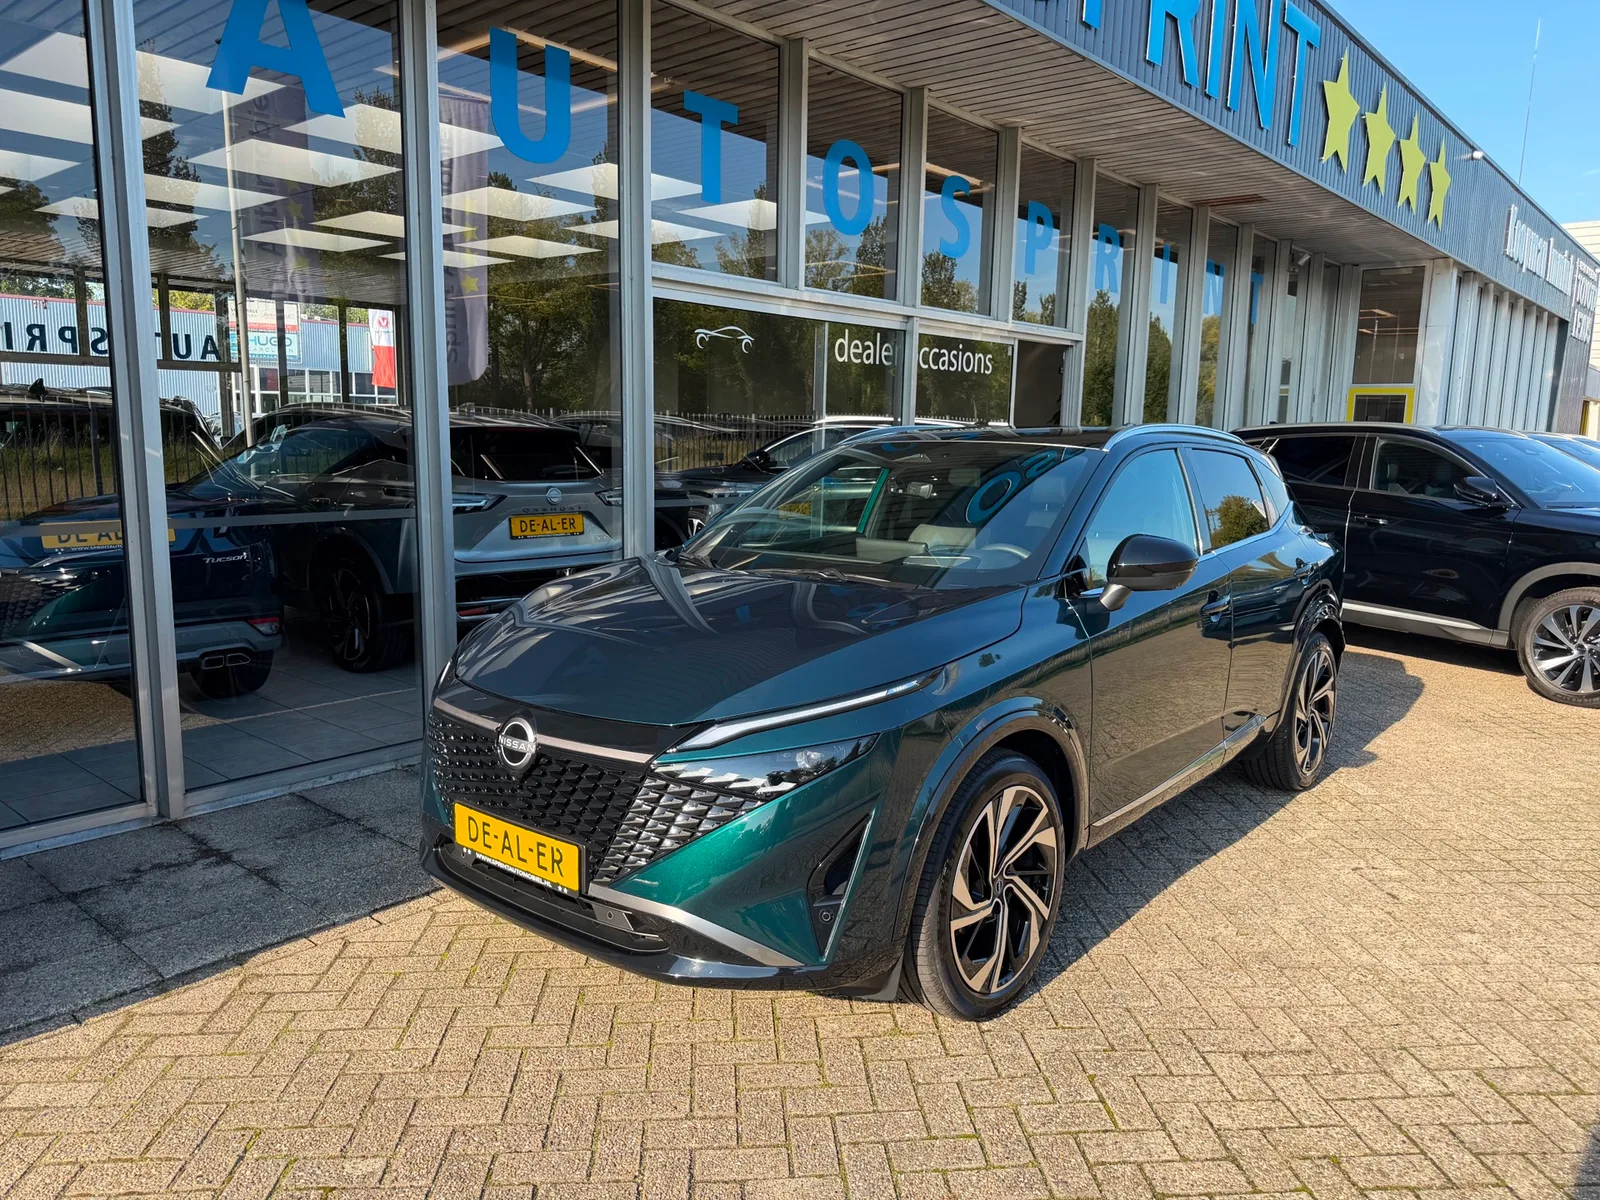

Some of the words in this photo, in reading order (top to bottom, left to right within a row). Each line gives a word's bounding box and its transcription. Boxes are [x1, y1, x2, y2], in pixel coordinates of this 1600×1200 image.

[917, 343, 993, 375] ccasions
[519, 517, 577, 533] DE-AL-ER
[498, 734, 536, 752] NISSAN
[467, 815, 565, 878] DE-AL-ER
